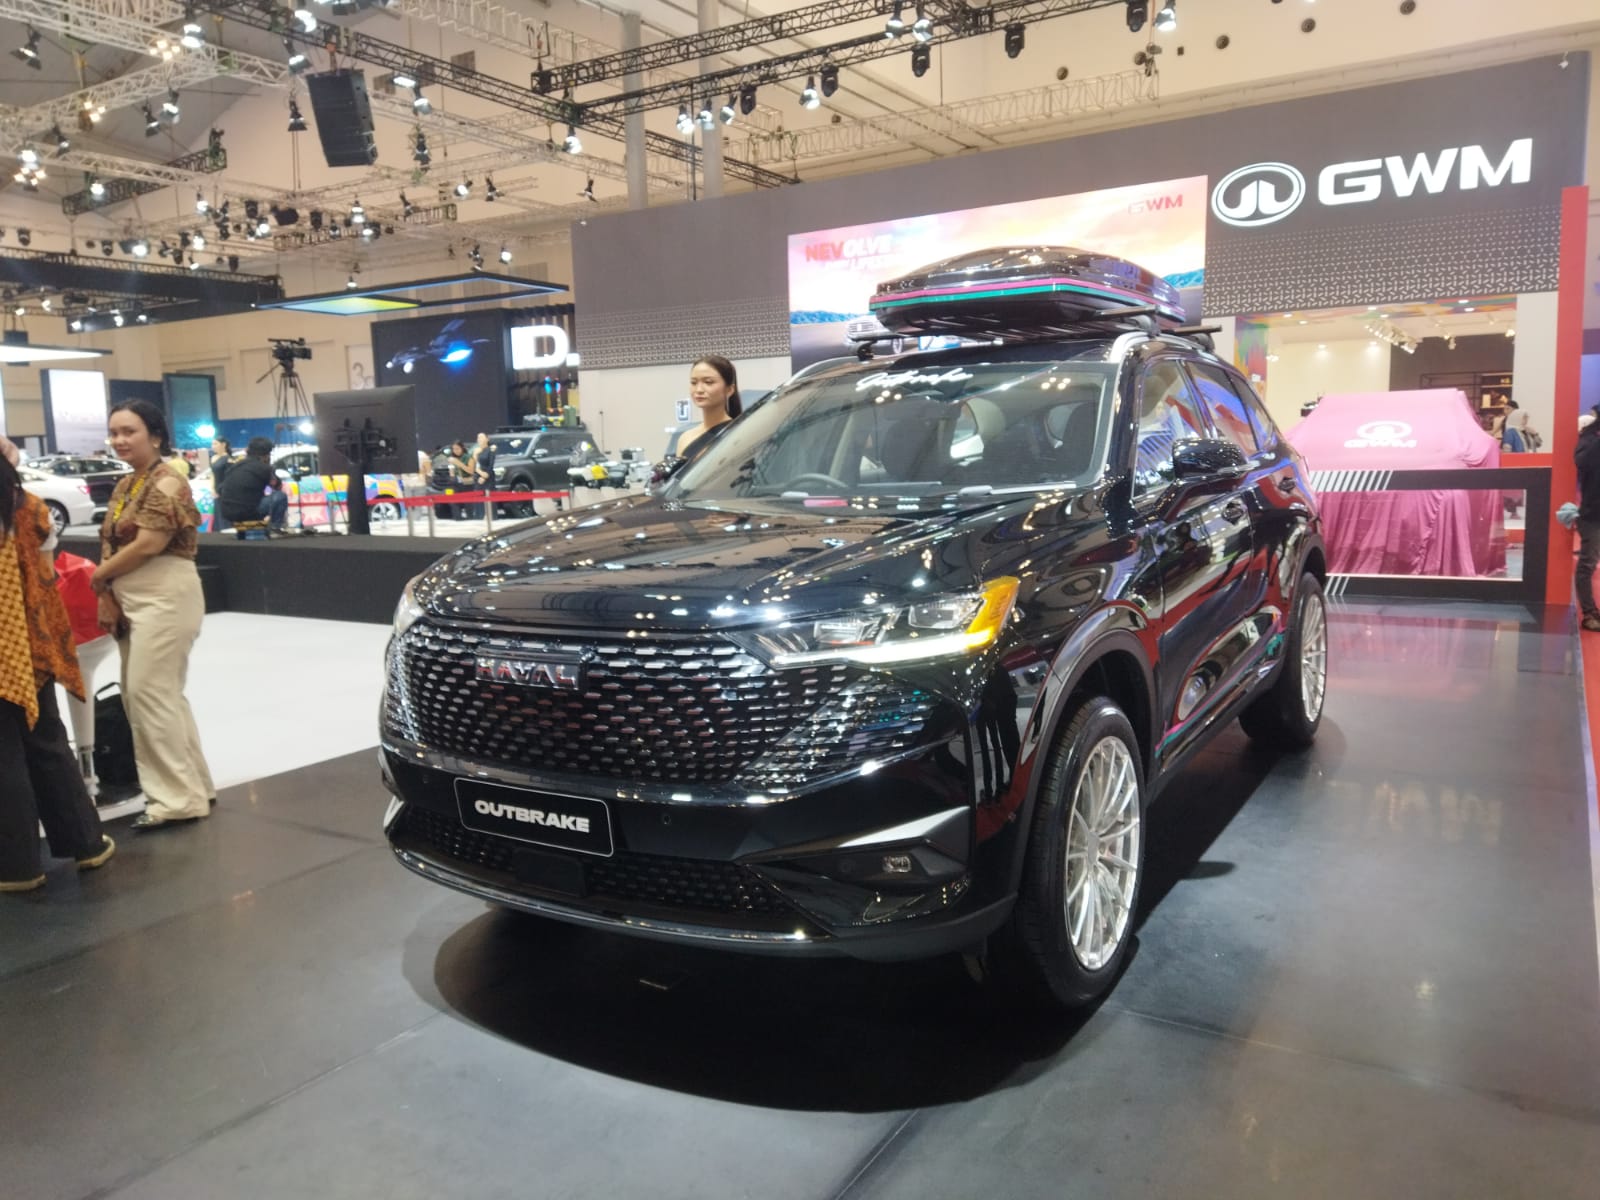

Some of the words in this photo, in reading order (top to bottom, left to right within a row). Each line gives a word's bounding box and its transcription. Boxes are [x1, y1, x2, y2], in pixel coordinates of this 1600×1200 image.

[1318, 138, 1533, 206] GWM
[475, 658, 579, 690] HAVAL
[474, 799, 590, 834] OUTBRAKE
